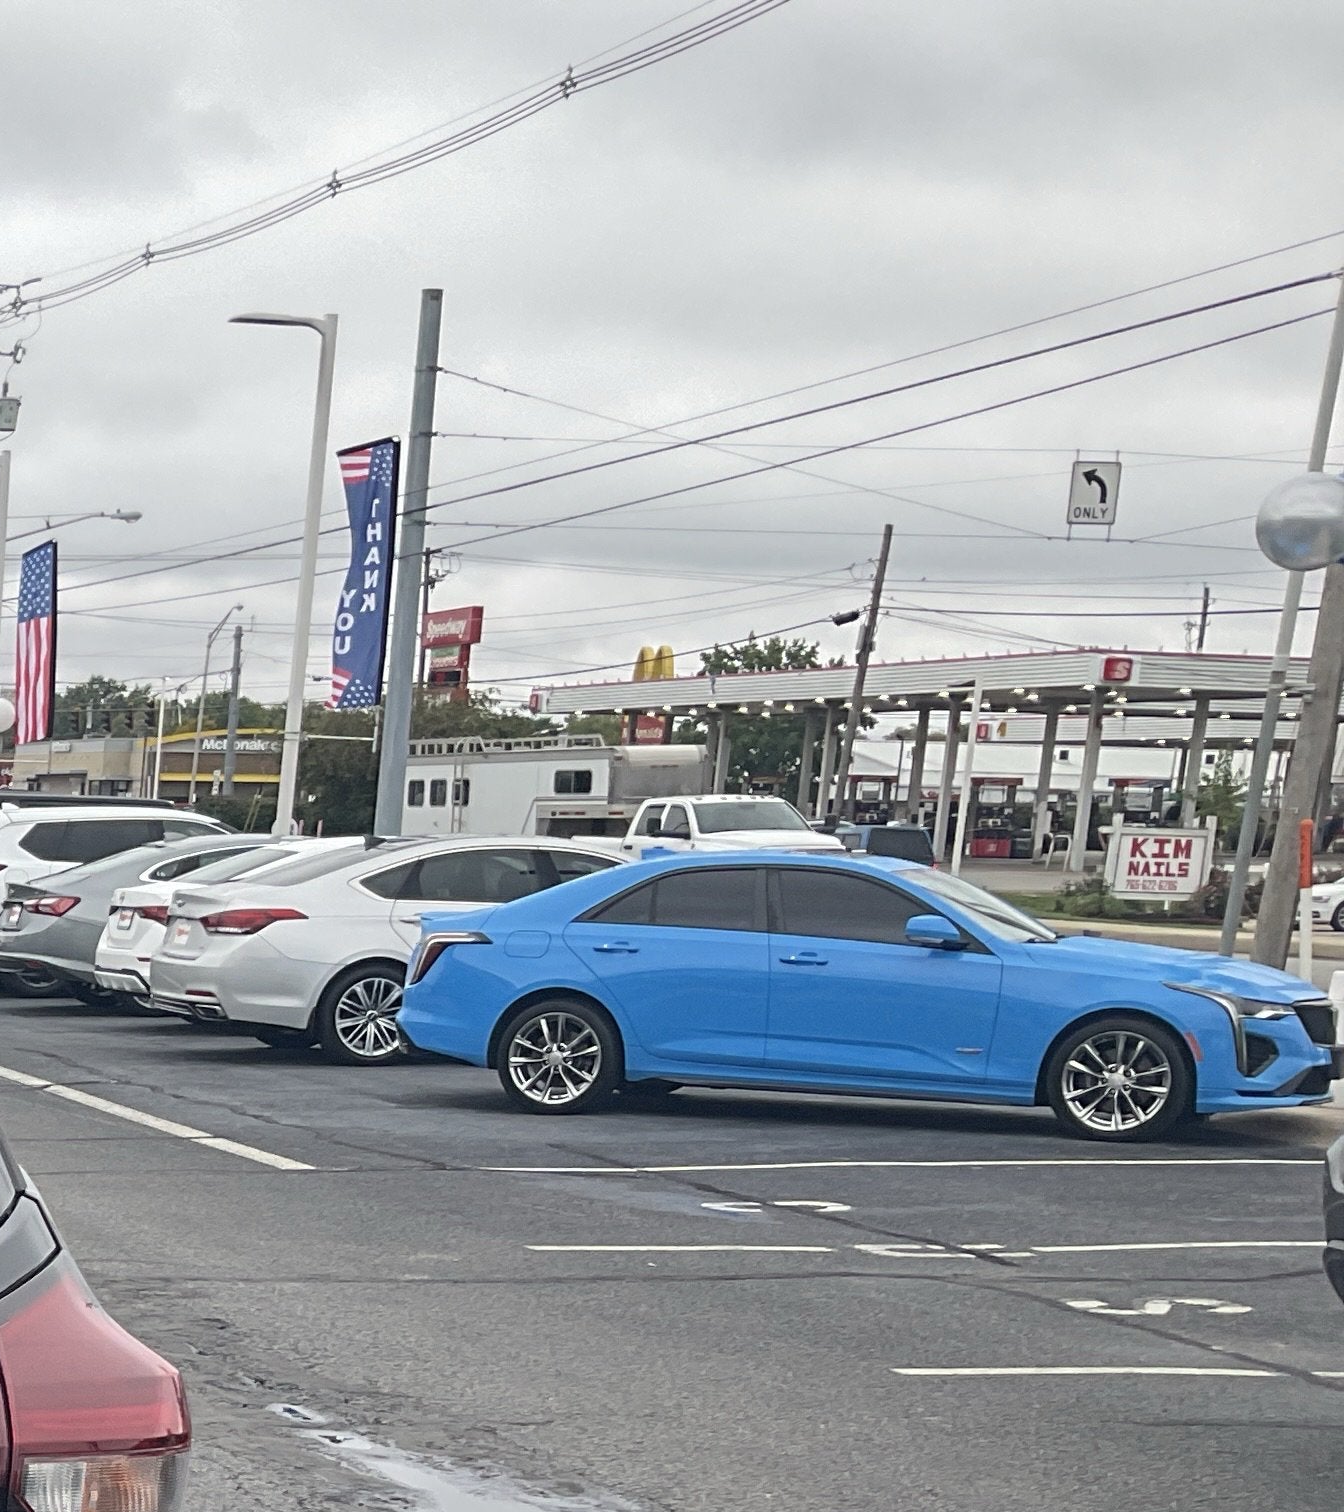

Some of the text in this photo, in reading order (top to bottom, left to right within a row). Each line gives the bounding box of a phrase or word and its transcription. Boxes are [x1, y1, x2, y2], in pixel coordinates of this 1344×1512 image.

[1073, 506, 1109, 519] ONLY
[1130, 837, 1193, 859] KIM
[1127, 861, 1190, 877] NAILS
